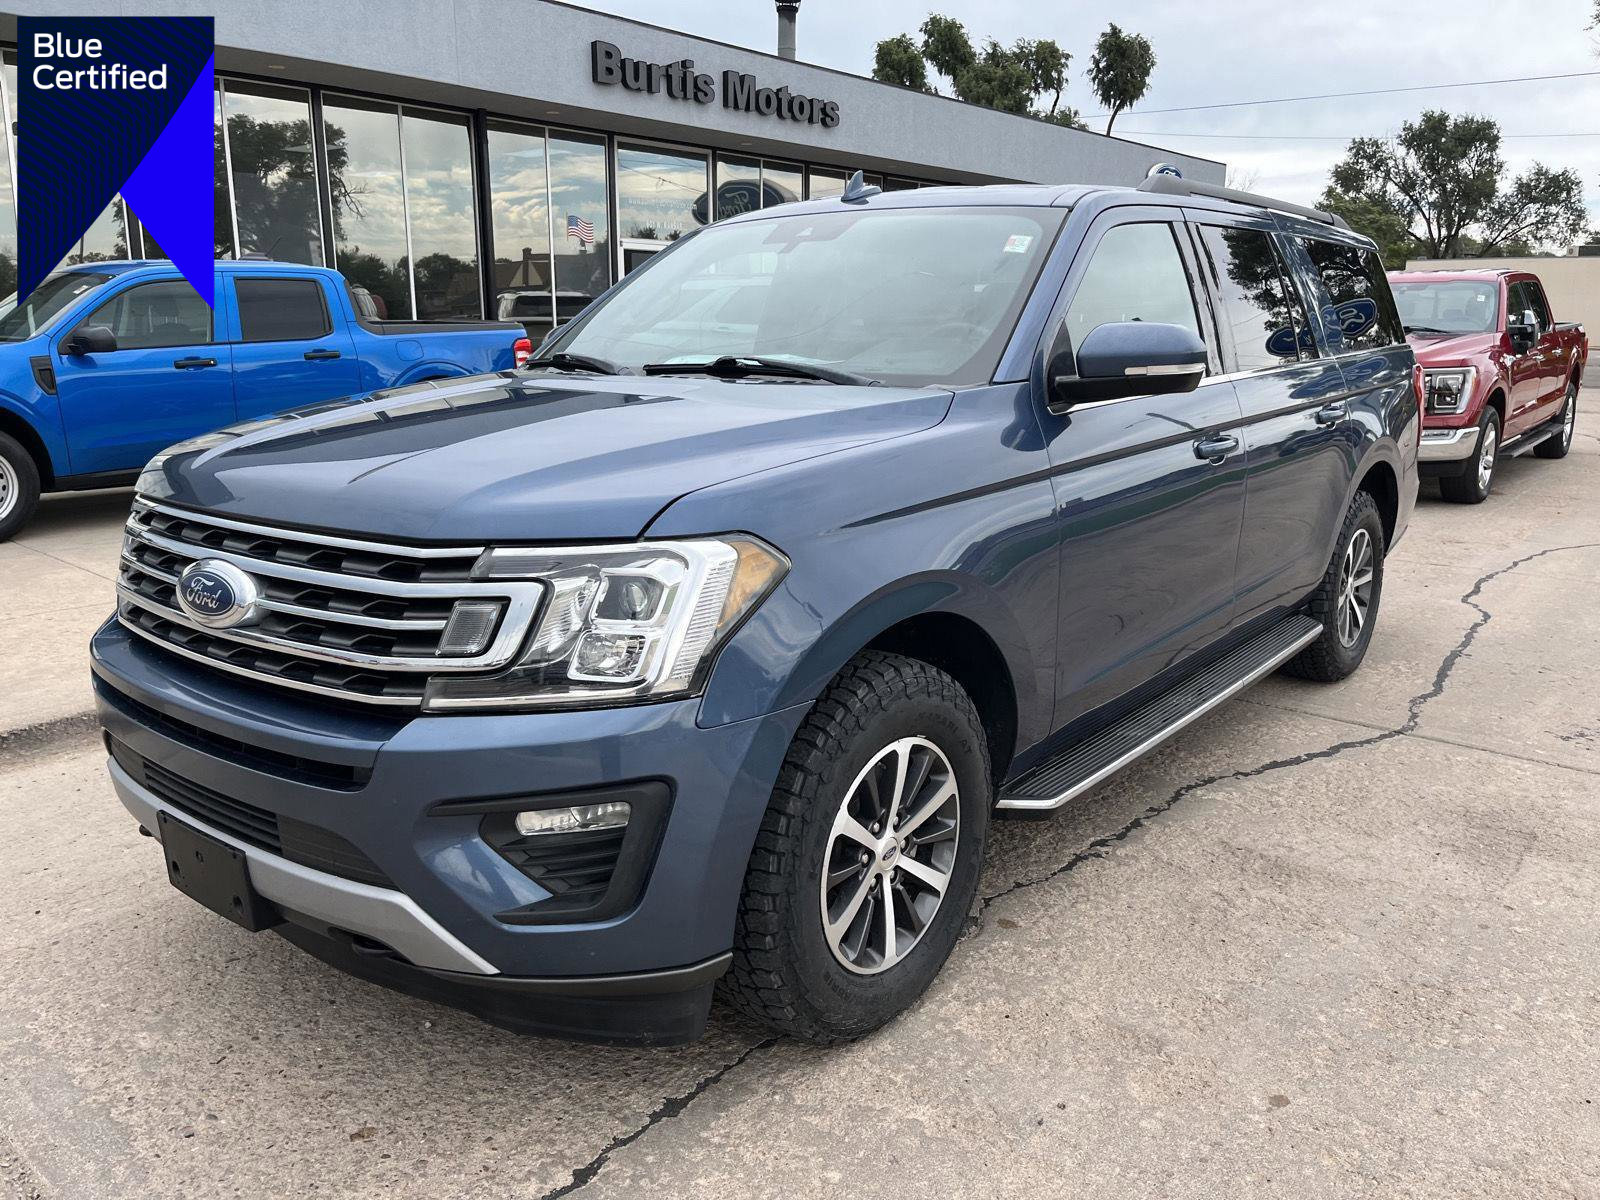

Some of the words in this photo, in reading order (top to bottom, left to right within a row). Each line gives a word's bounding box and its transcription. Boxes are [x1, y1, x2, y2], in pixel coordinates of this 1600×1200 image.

[591, 40, 715, 104] Burtis
[722, 69, 840, 128] Motors
[186, 576, 222, 609] Ford
